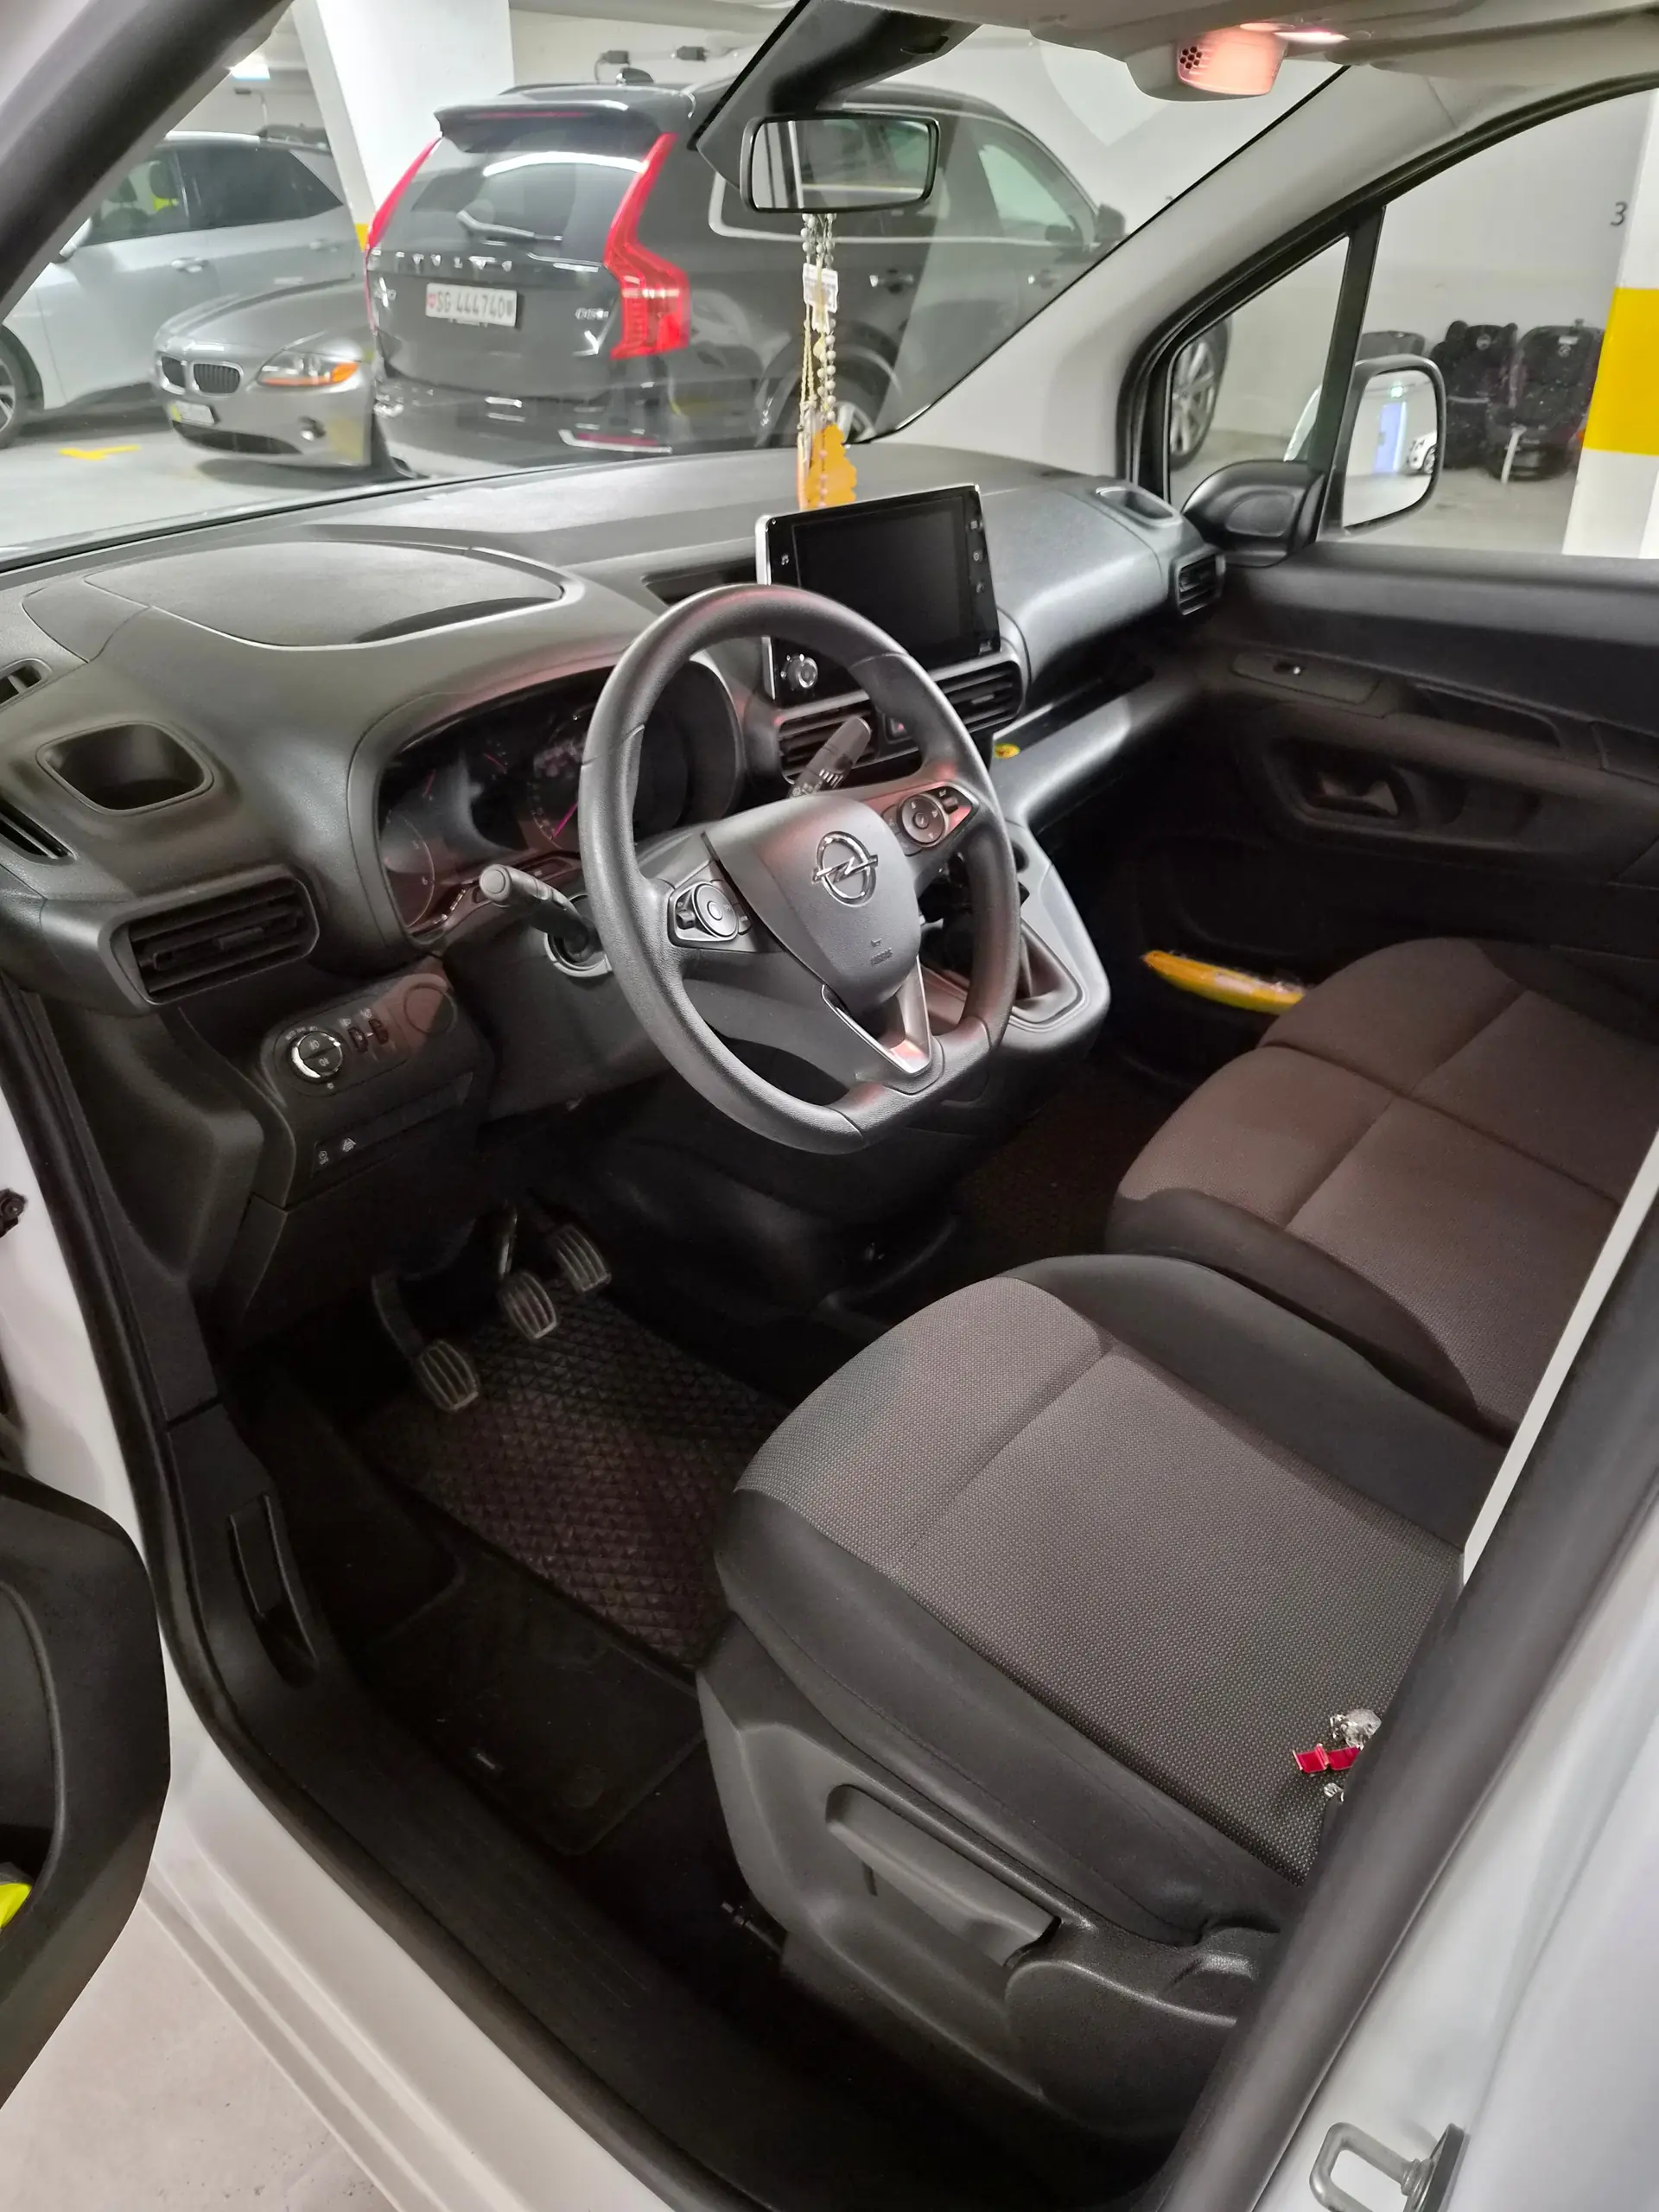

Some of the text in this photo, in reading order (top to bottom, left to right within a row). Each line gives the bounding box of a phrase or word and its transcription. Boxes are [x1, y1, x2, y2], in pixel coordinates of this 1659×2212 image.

[1610, 200, 1628, 226] 3
[436, 290, 505, 318] SG 444740
